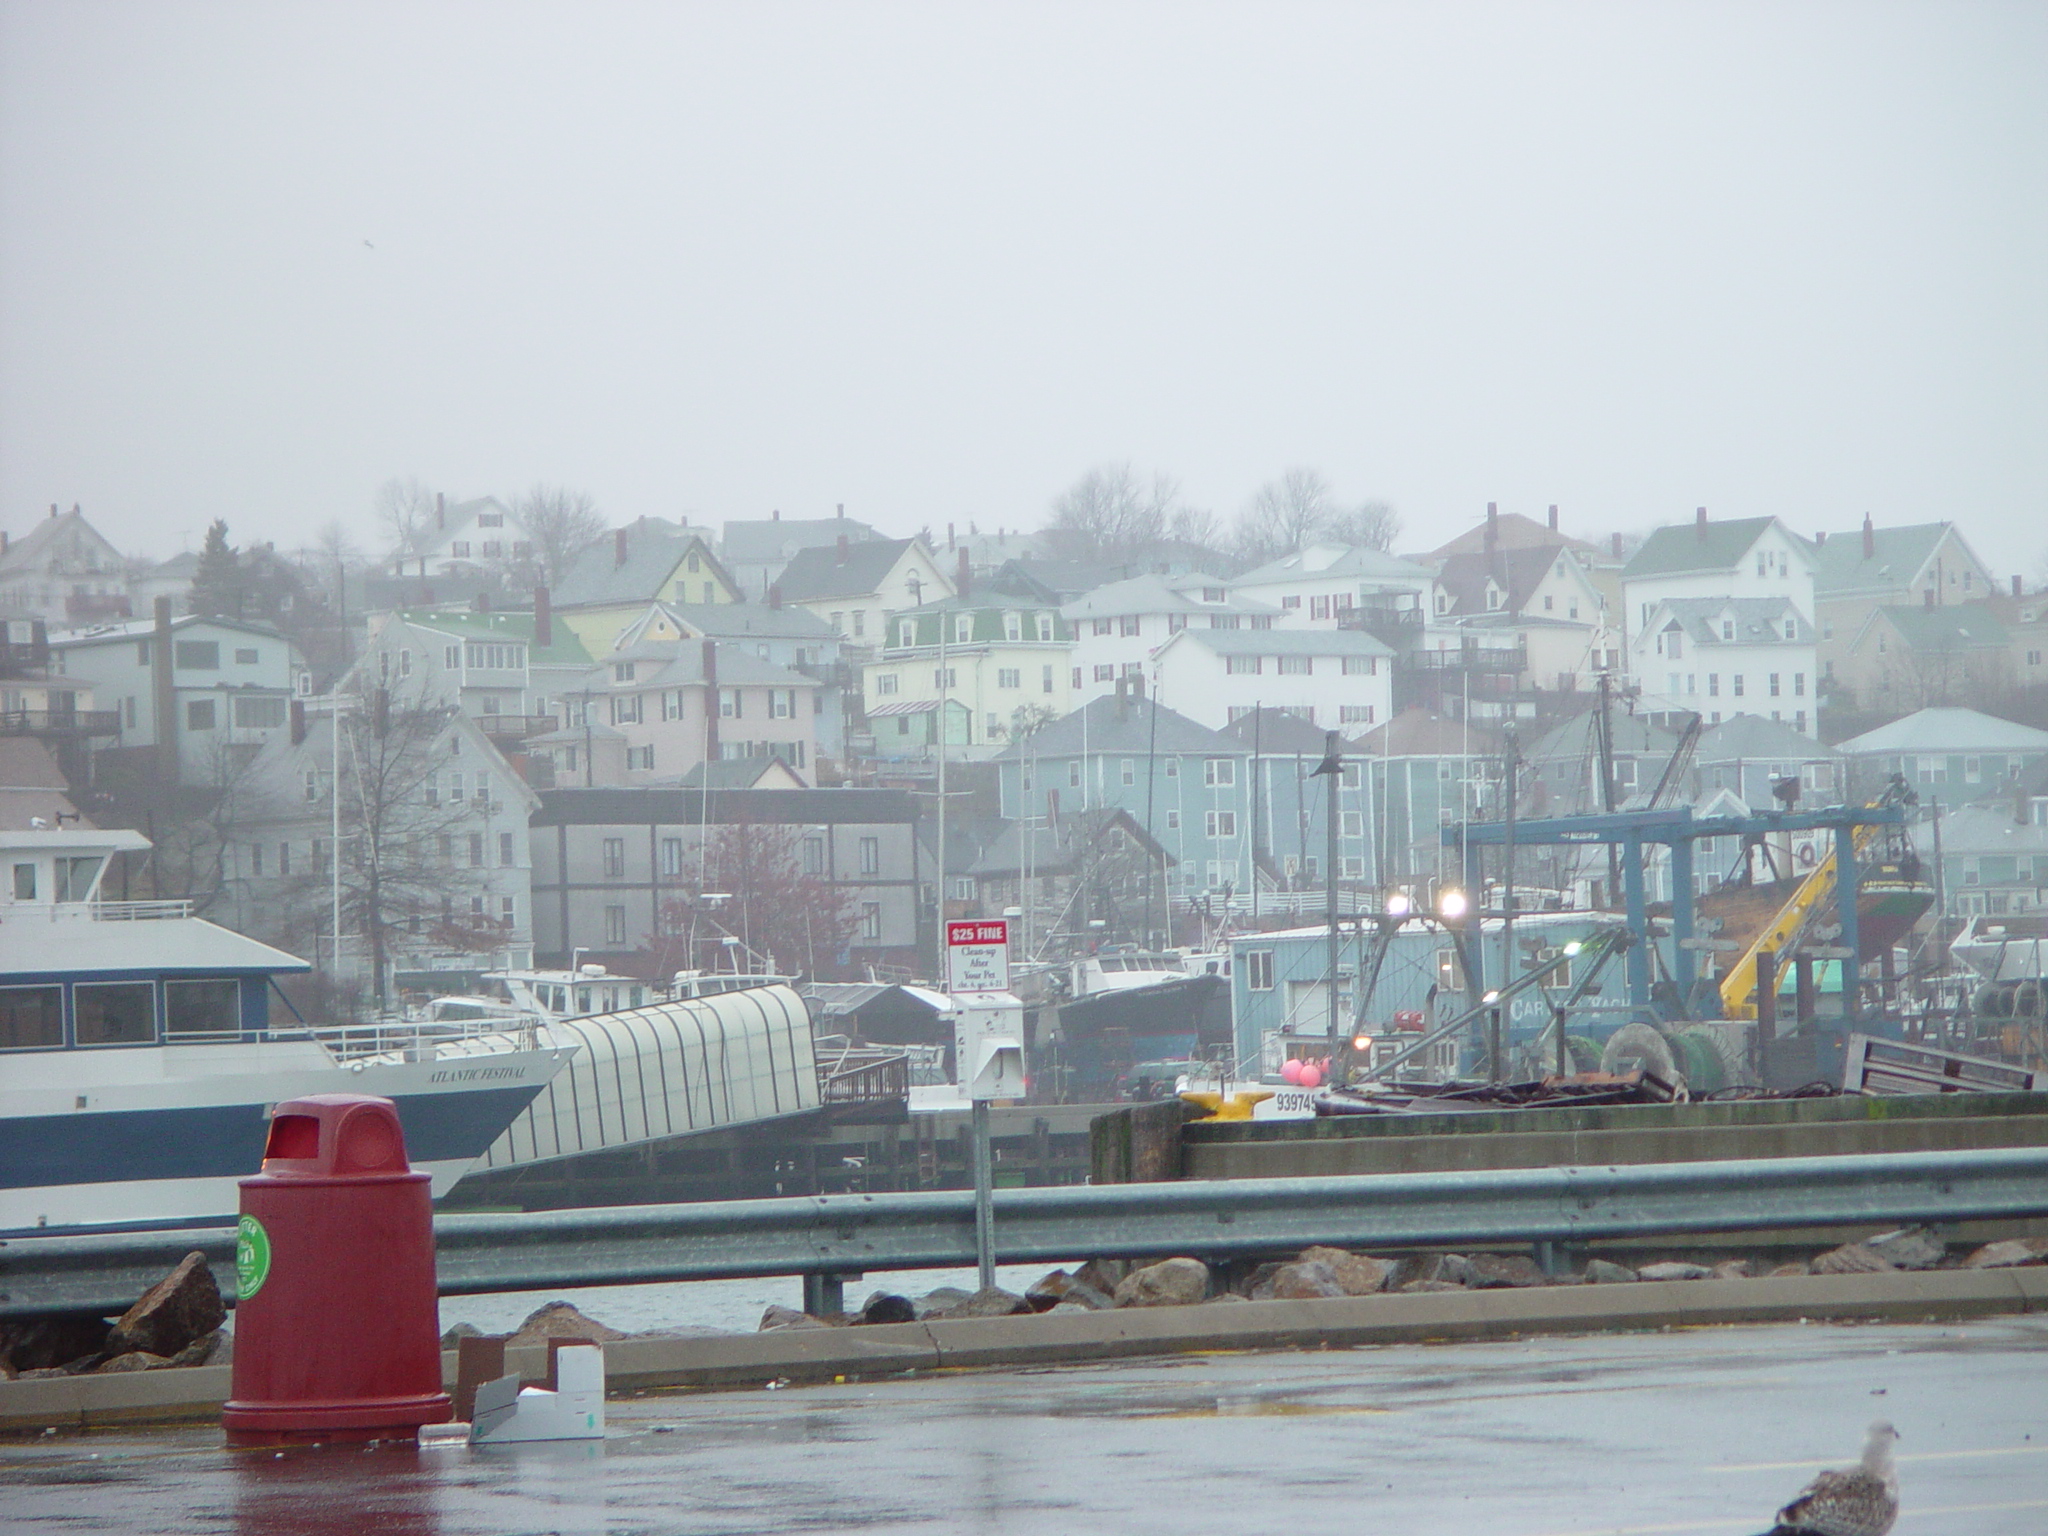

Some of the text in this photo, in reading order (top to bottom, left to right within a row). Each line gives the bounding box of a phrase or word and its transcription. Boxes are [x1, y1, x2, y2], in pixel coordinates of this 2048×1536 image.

[952, 926, 1004, 941] $25 FINE
[961, 946, 997, 957] Clean-up
[970, 958, 989, 967] After
[963, 969, 995, 980] Your Pet
[428, 1066, 526, 1083] ATLANTIC FESTIVAL
